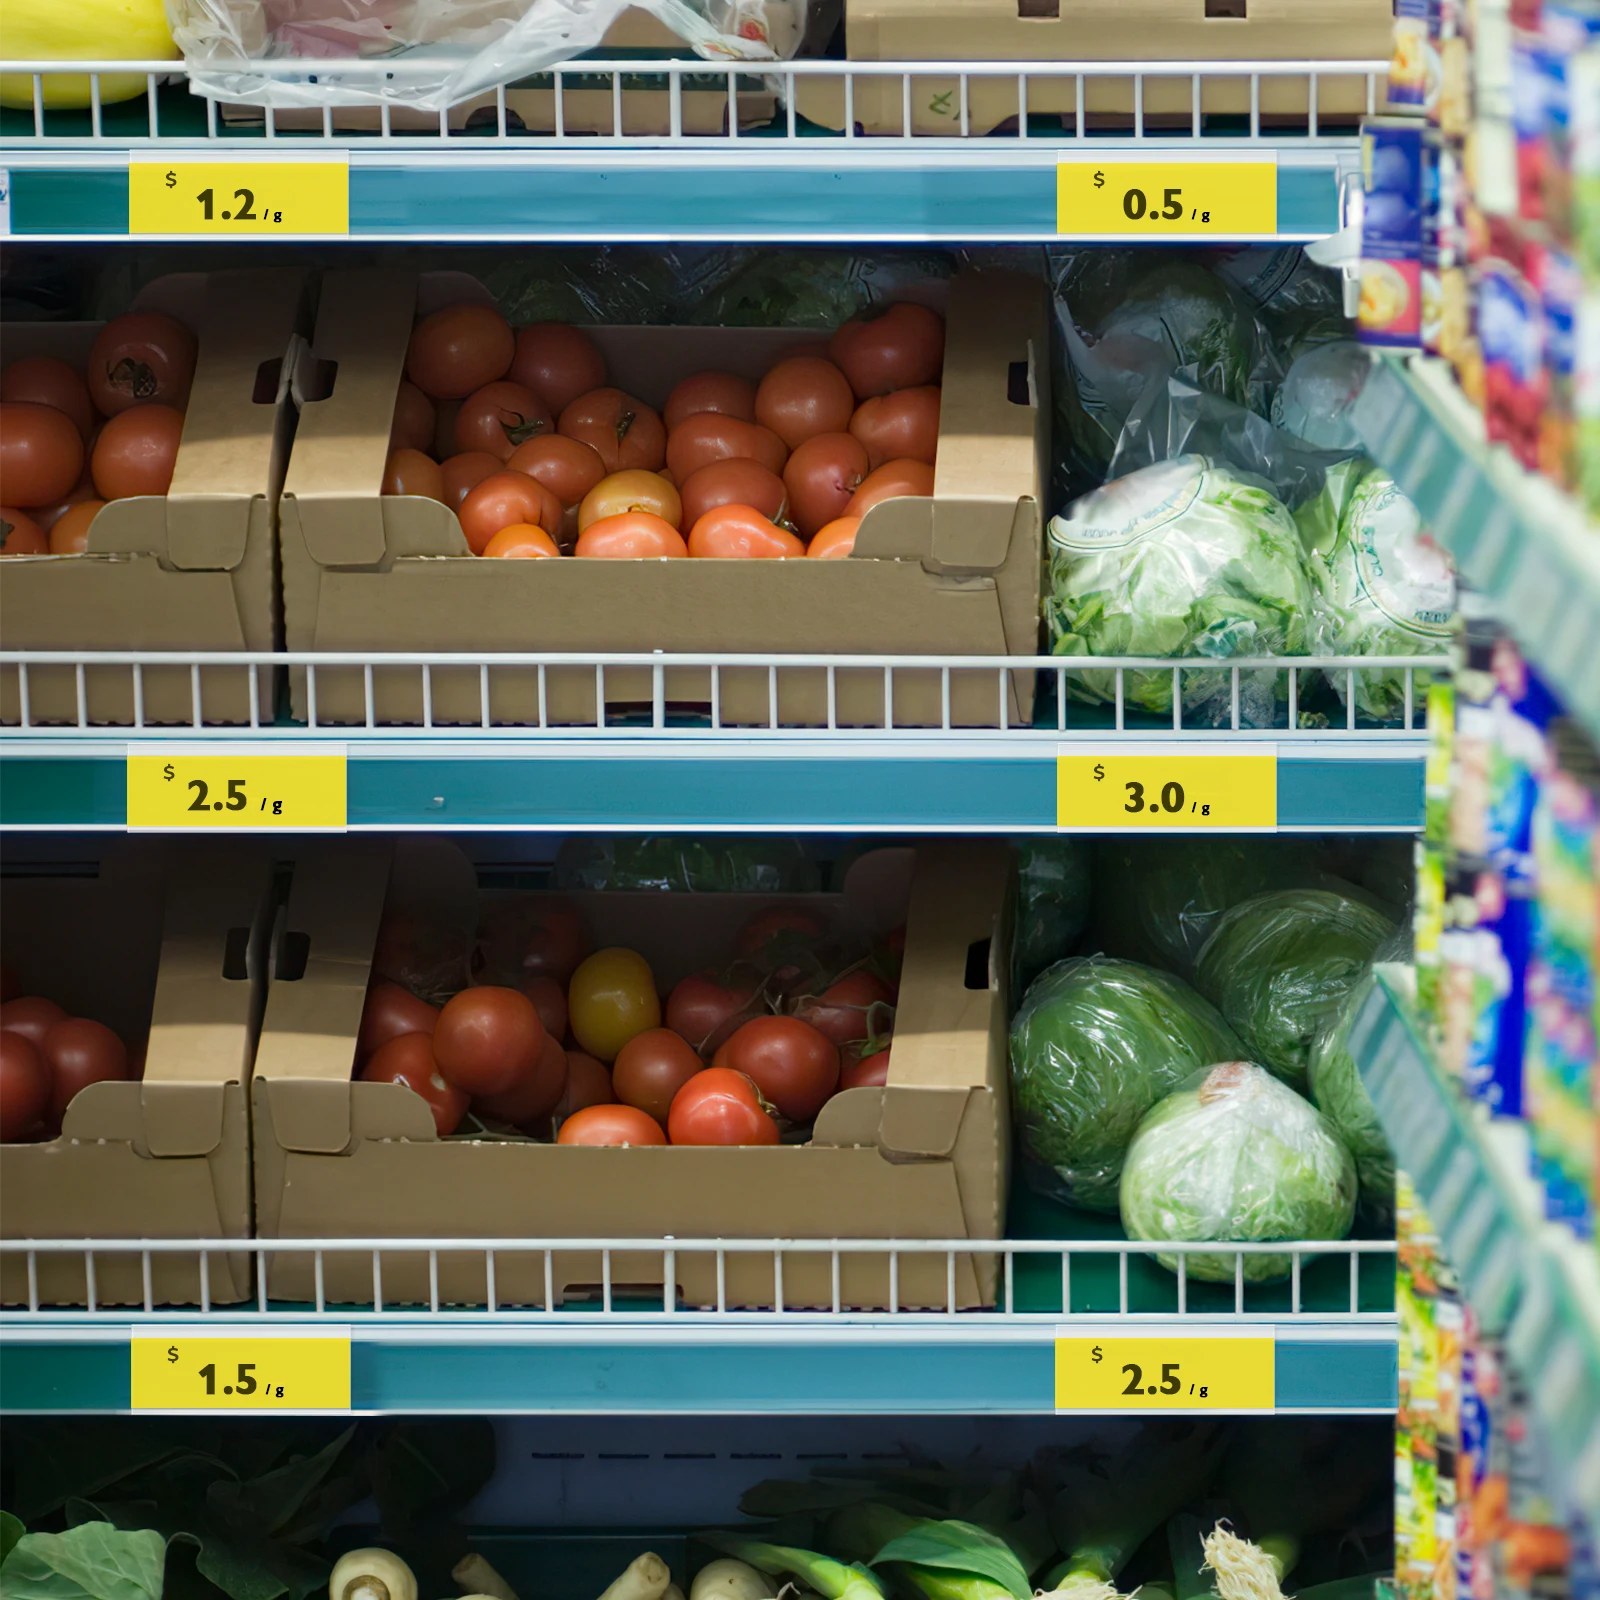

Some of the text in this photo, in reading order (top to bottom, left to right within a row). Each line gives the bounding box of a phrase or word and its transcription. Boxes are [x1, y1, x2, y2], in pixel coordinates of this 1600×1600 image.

[165, 170, 177, 189] $
[196, 188, 257, 221] 1.2
[1093, 170, 1105, 189] $
[1122, 188, 1183, 221] 0.5
[163, 763, 175, 782] $
[187, 779, 247, 811] 2.5
[1093, 763, 1105, 782] $
[1124, 781, 1185, 814] 3.0
[167, 1345, 179, 1364] $
[198, 1363, 257, 1395] 1.5
[1091, 1345, 1103, 1364] $
[1121, 1363, 1182, 1396] 2.5
